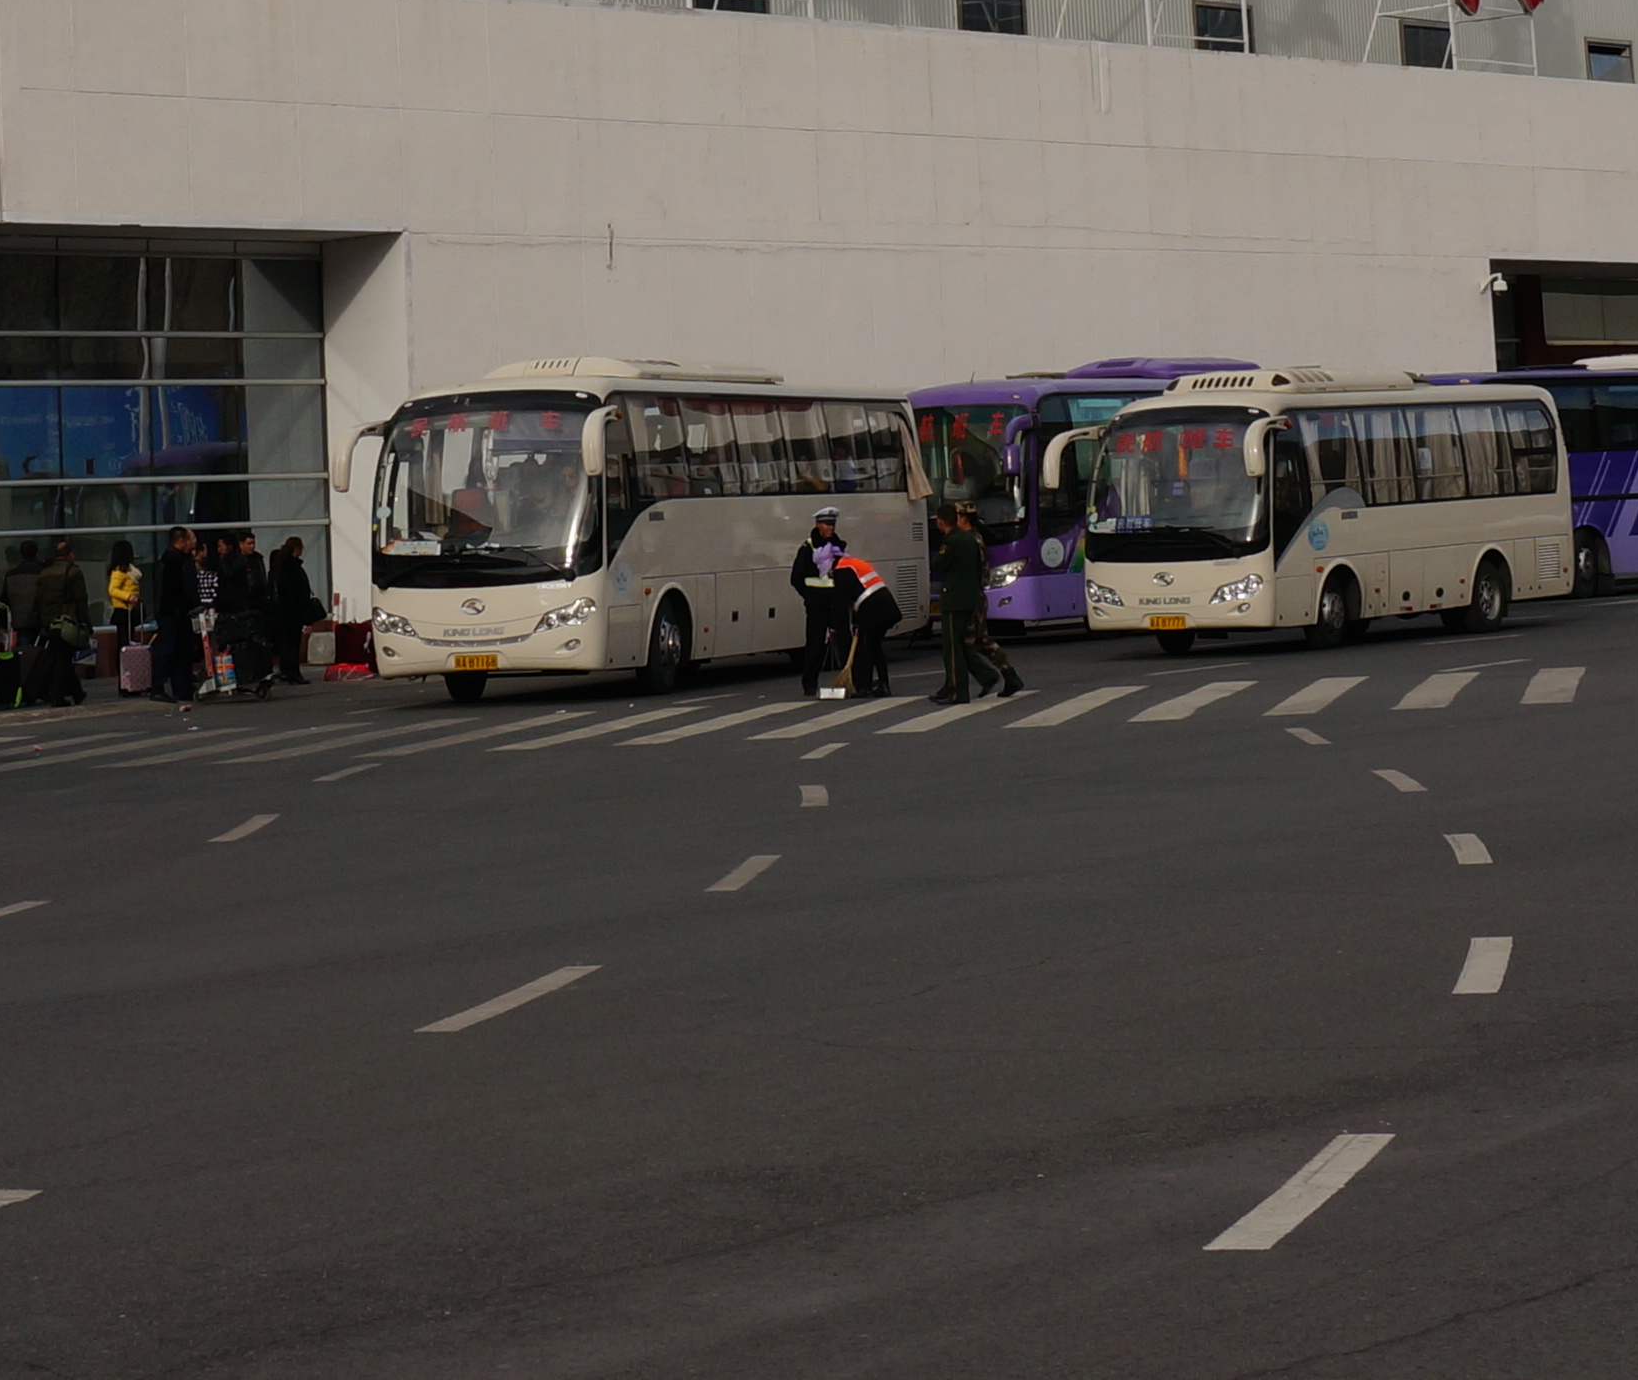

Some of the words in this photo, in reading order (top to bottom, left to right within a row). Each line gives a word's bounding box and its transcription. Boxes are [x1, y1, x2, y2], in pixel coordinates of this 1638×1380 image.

[411, 409, 563, 438] 民航班车
[1114, 428, 1237, 455] 民航班车
[1138, 597, 1161, 605] KING
[1163, 596, 1191, 605] LONG
[443, 628, 470, 637] KING
[472, 626, 505, 636] LONG
